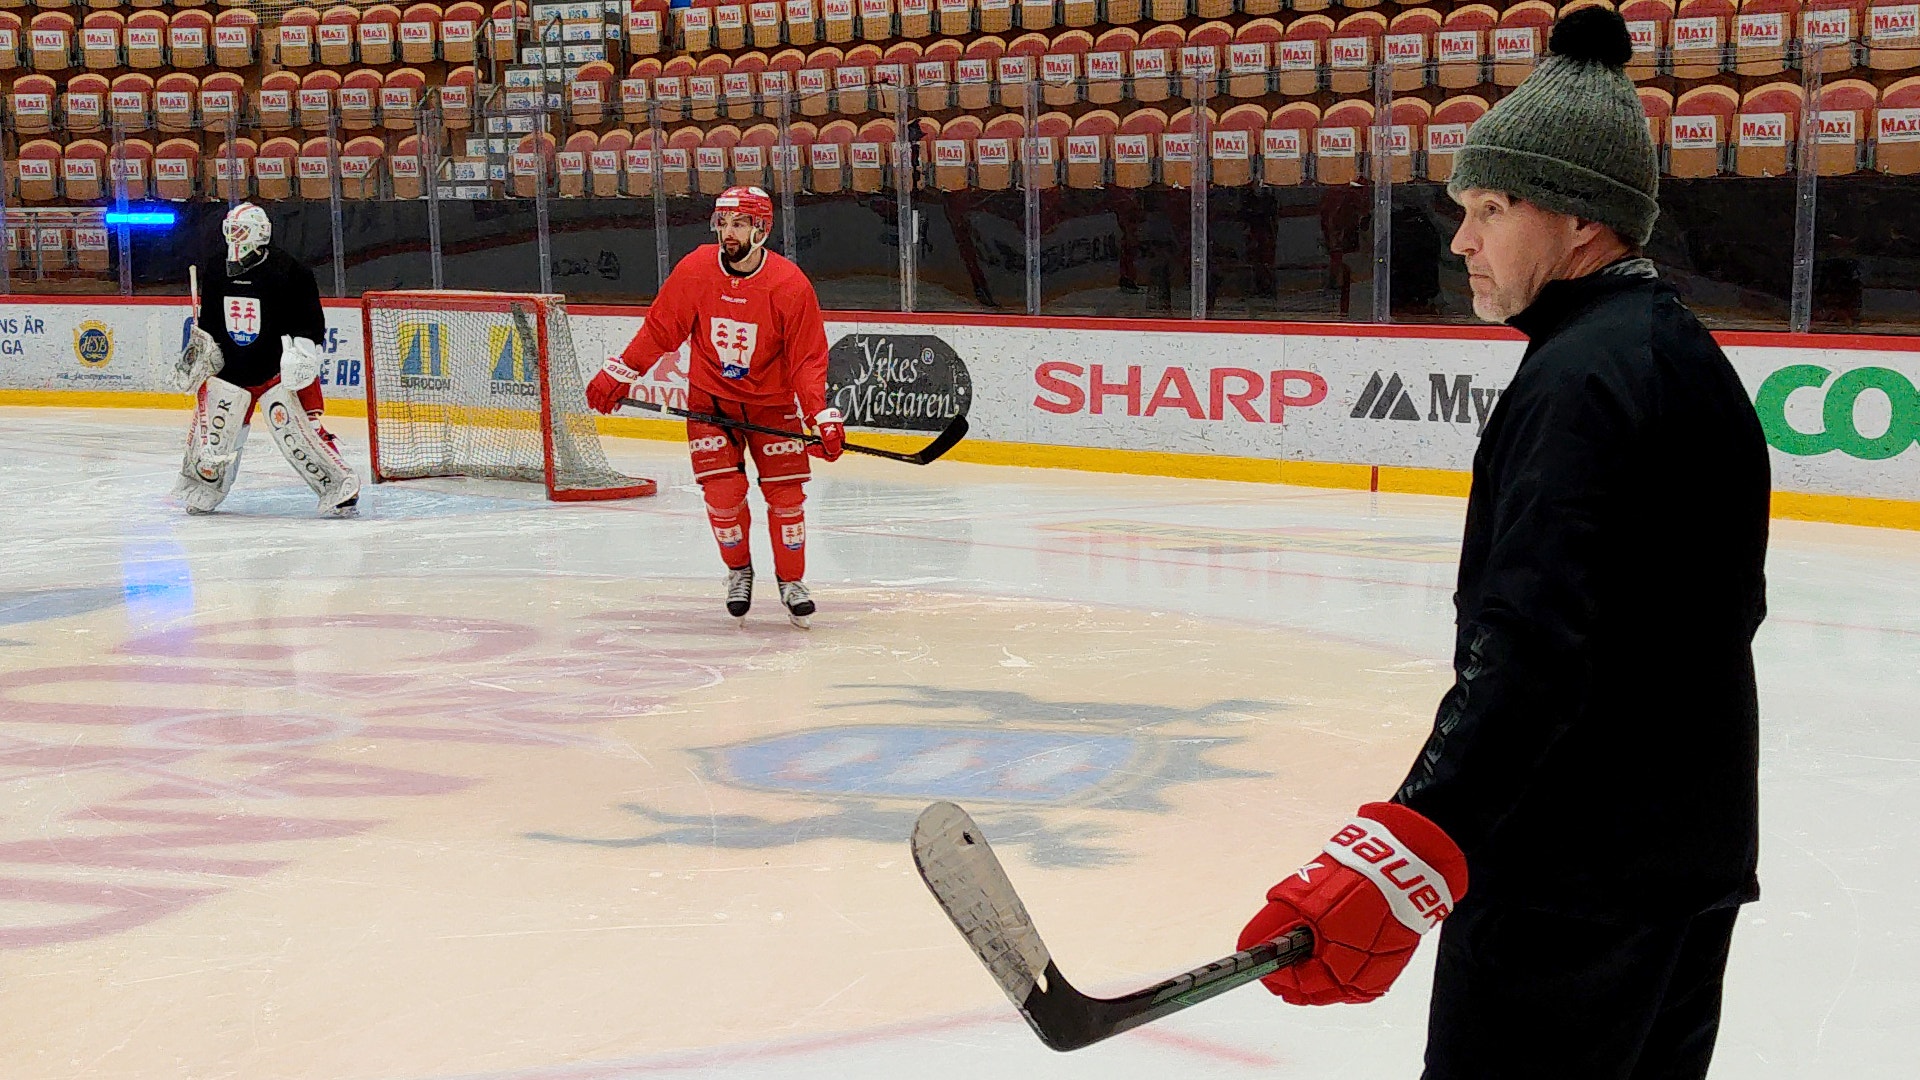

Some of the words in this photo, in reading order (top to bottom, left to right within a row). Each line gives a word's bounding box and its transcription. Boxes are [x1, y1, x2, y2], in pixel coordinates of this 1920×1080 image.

[787, 4, 807, 15] MAXI
[826, 3, 849, 13] MAXI
[863, 0, 886, 12] MAXI
[719, 12, 740, 21] MAXI
[754, 7, 774, 18] MAXI
[631, 17, 654, 28] MAXI
[685, 13, 708, 24] MAXI
[1874, 14, 1915, 30] MAXI
[361, 28, 387, 39] MAXI
[403, 27, 428, 38] MAXI
[443, 25, 470, 36] MAXI
[1677, 26, 1714, 40] MAXI
[1740, 23, 1779, 37] MAXI
[1807, 21, 1846, 35] MAXI
[34, 36, 61, 45] MAXI
[86, 33, 111, 44] MAXI
[130, 33, 156, 43] MAXI
[174, 33, 200, 43] MAXI
[217, 31, 243, 41] MAXI
[281, 30, 304, 41] MAXI
[322, 30, 346, 40] MAXI
[1388, 43, 1421, 55] MAXI
[1441, 39, 1474, 53] MAXI
[1497, 38, 1531, 52] MAXI
[1233, 52, 1263, 65] MAXI
[1282, 49, 1312, 62] MAXI
[1334, 46, 1365, 60] MAXI
[1091, 59, 1119, 72] MAXI
[1135, 59, 1163, 71] MAXI
[1184, 54, 1213, 66] MAXI
[960, 67, 985, 79] MAXI
[1045, 62, 1073, 74] MAXI
[839, 74, 863, 86] MAXI
[918, 70, 943, 81] MAXI
[726, 80, 748, 91] MAXI
[763, 78, 787, 89] MAXI
[800, 76, 823, 88] MAXI
[573, 86, 596, 98] MAXI
[625, 85, 643, 96] MAXI
[658, 84, 679, 96] MAXI
[694, 83, 713, 94] MAXI
[113, 97, 139, 107] MAXI
[159, 97, 187, 107] MAXI
[261, 95, 285, 106] MAXI
[301, 94, 327, 104] MAXI
[341, 93, 367, 103] MAXI
[384, 93, 409, 104] MAXI
[443, 92, 466, 102] MAXI
[17, 98, 45, 109] MAXI
[70, 99, 96, 110] MAXI
[1675, 126, 1714, 140] MAXI
[1742, 123, 1782, 137] MAXI
[1214, 138, 1245, 151] MAXI
[1267, 138, 1297, 151] MAXI
[1320, 135, 1351, 148] MAXI
[1430, 132, 1465, 146] MAXI
[813, 150, 837, 161] MAXI
[853, 149, 877, 161] MAXI
[937, 148, 963, 160] MAXI
[979, 146, 1007, 157] MAXI
[1070, 144, 1097, 156] MAXI
[1117, 144, 1146, 156] MAXI
[560, 158, 581, 168] MAXI
[592, 157, 616, 168] MAXI
[628, 156, 650, 167] MAXI
[699, 154, 722, 165] MAXI
[735, 153, 760, 164] MAXI
[20, 164, 47, 175] MAXI
[66, 164, 92, 174] MAXI
[158, 164, 185, 173] MAXI
[257, 163, 282, 173] MAXI
[300, 162, 324, 172] MAXI
[342, 162, 366, 172] MAXI
[394, 162, 416, 172] MAXI
[77, 233, 106, 245] MAXI
[24, 315, 45, 334] ÄR
[2, 340, 24, 355] GA
[80, 335, 107, 353] HSB
[853, 336, 919, 386] Yrkes
[336, 360, 361, 386] AB
[400, 376, 452, 391] EUROCON
[490, 381, 537, 397] EUROCO
[1033, 361, 1328, 423] SHARP
[283, 433, 332, 488] COOR
[1330, 823, 1451, 930] BAUER
